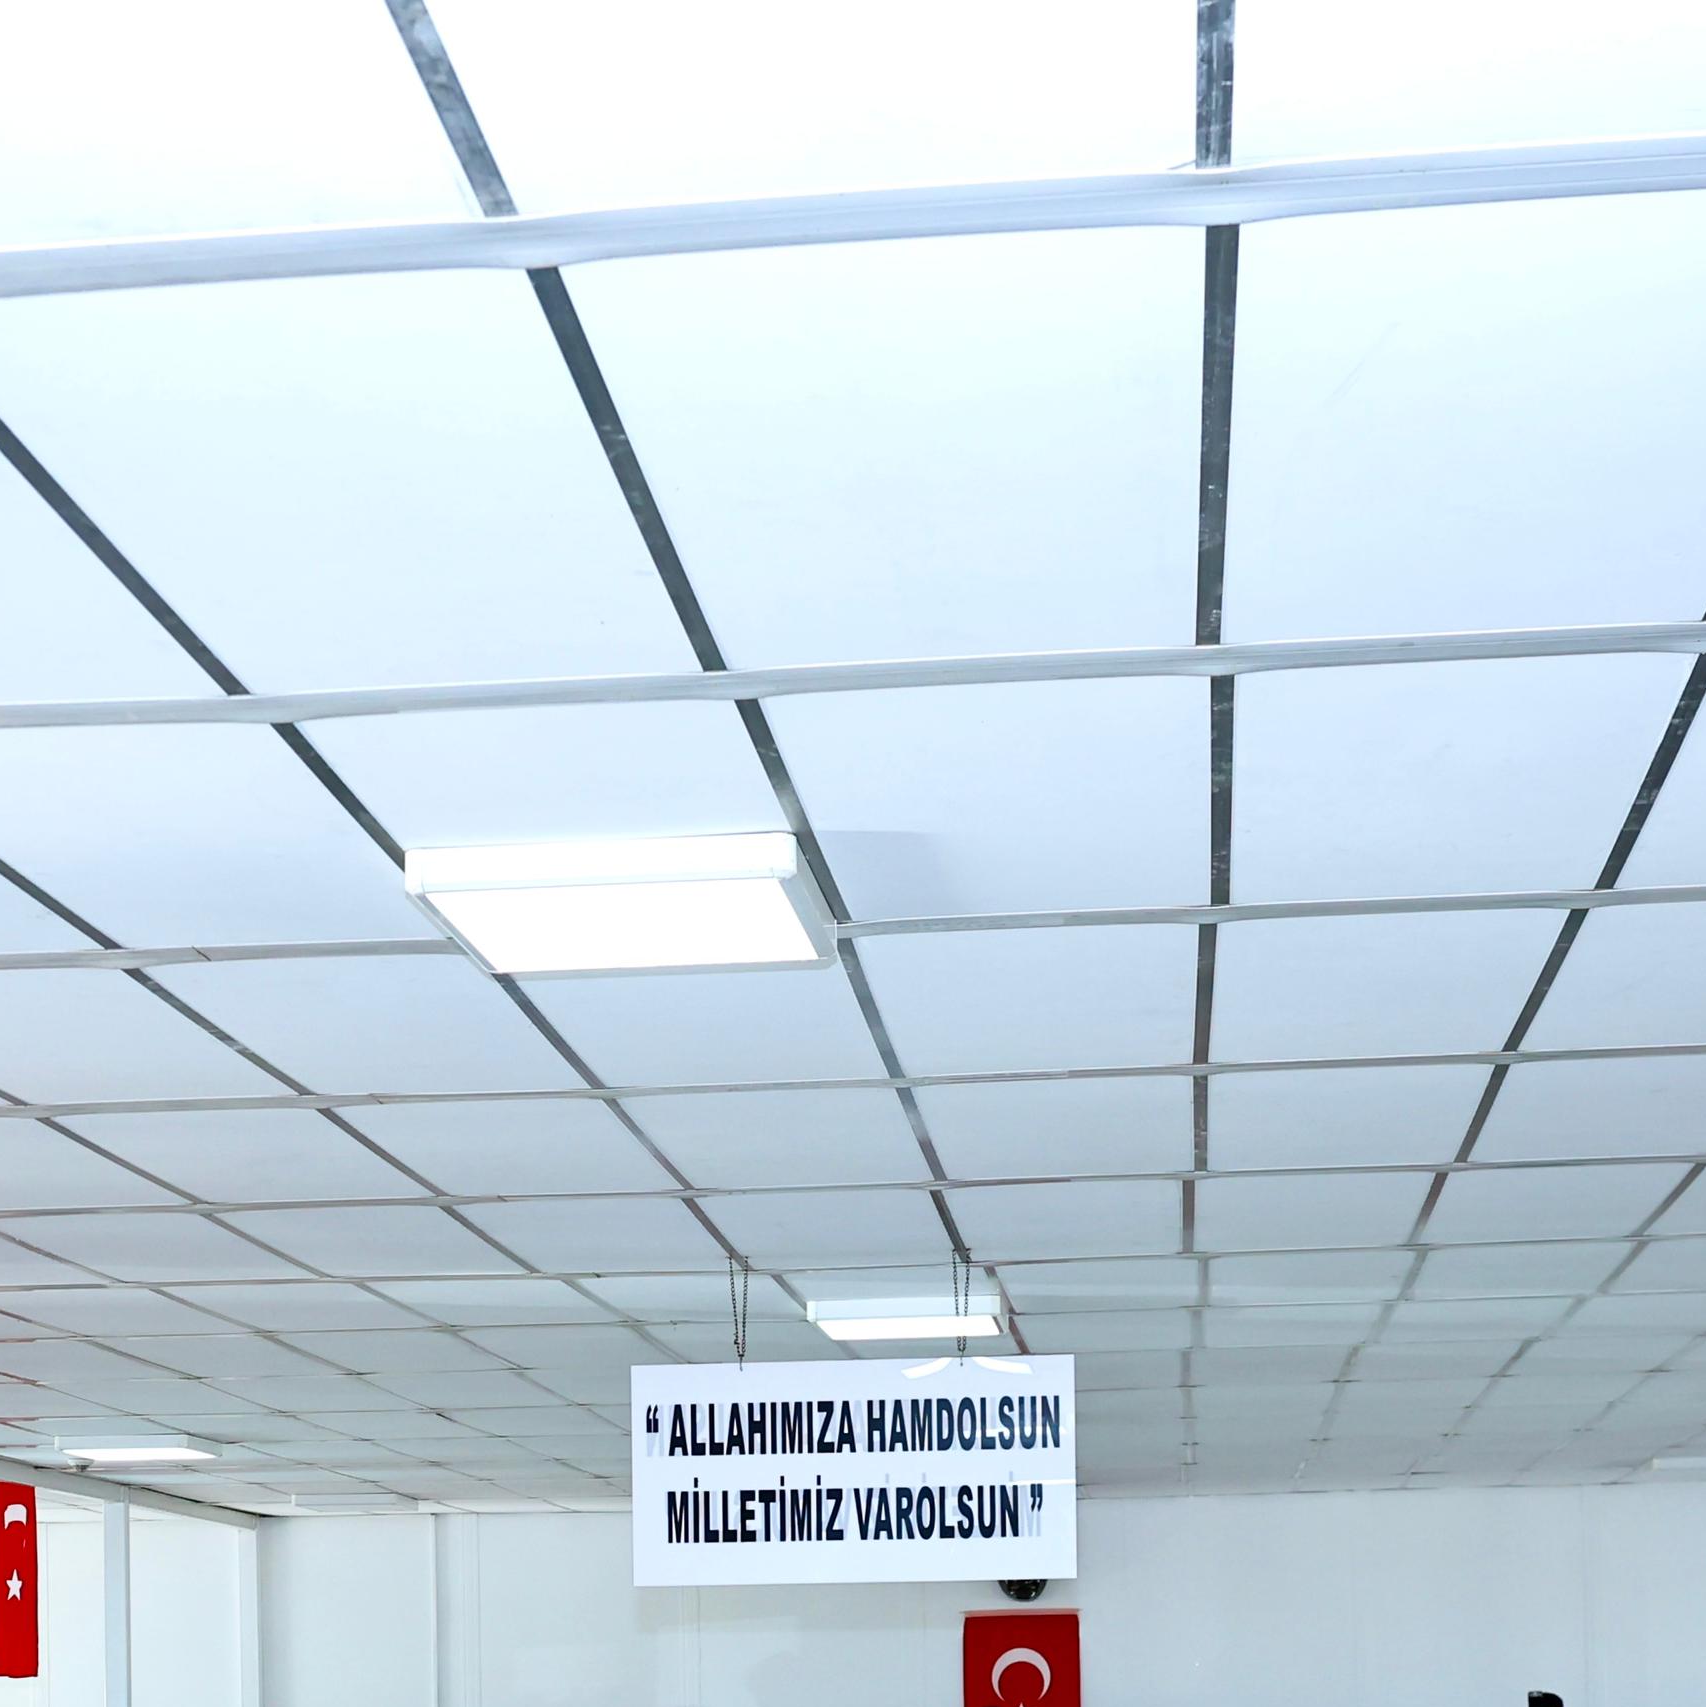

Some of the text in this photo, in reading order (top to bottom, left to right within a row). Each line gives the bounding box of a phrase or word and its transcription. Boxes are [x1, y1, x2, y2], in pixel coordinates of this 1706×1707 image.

[668, 1400, 857, 1456] ALLAHIMIZA
[867, 1395, 1061, 1453] HAMDOLSUN
[667, 1475, 844, 1543] MİLLETİMİZ
[854, 1484, 1019, 1541] VAROLSUN
